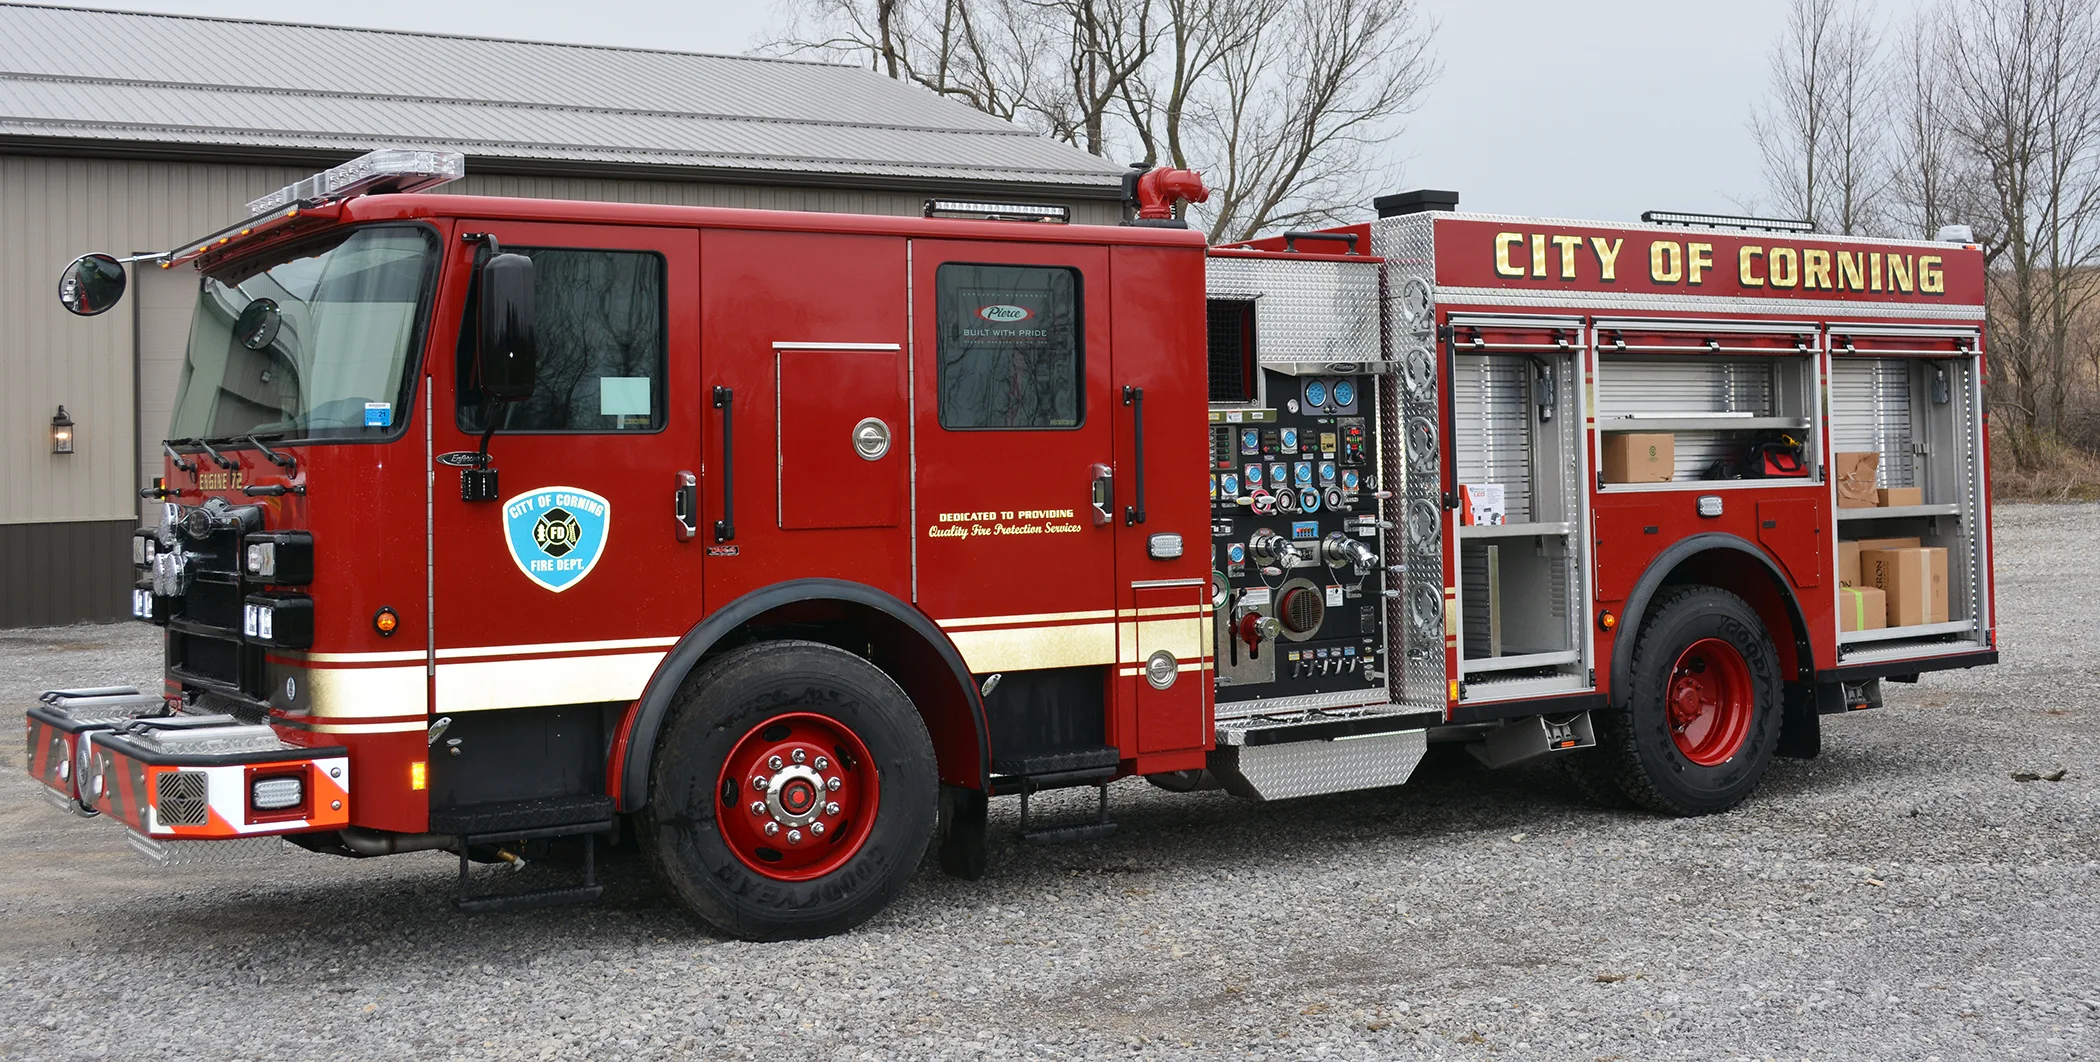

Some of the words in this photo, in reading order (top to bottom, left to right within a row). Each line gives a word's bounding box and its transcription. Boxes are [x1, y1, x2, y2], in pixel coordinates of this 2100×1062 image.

[1494, 231, 1625, 280] CITY
[1649, 239, 1714, 286] OF
[1738, 245, 1946, 294] CORNING
[987, 306, 1021, 319] Pierce
[199, 473, 227, 491] ENGINE
[231, 472, 242, 490] 72
[508, 498, 534, 519] CITY
[537, 494, 552, 508] OF
[556, 493, 605, 518] CORNING
[939, 511, 997, 522] DEDICATED
[1000, 510, 1014, 520] TO
[1018, 509, 1074, 520] PROVIDING
[550, 526, 565, 540] FD
[928, 524, 969, 540] Quality
[970, 523, 992, 537] Fire
[993, 522, 1043, 536] Protection
[1044, 521, 1082, 534] Services
[530, 559, 554, 572] FIRE
[556, 558, 585, 571] DEPT.
